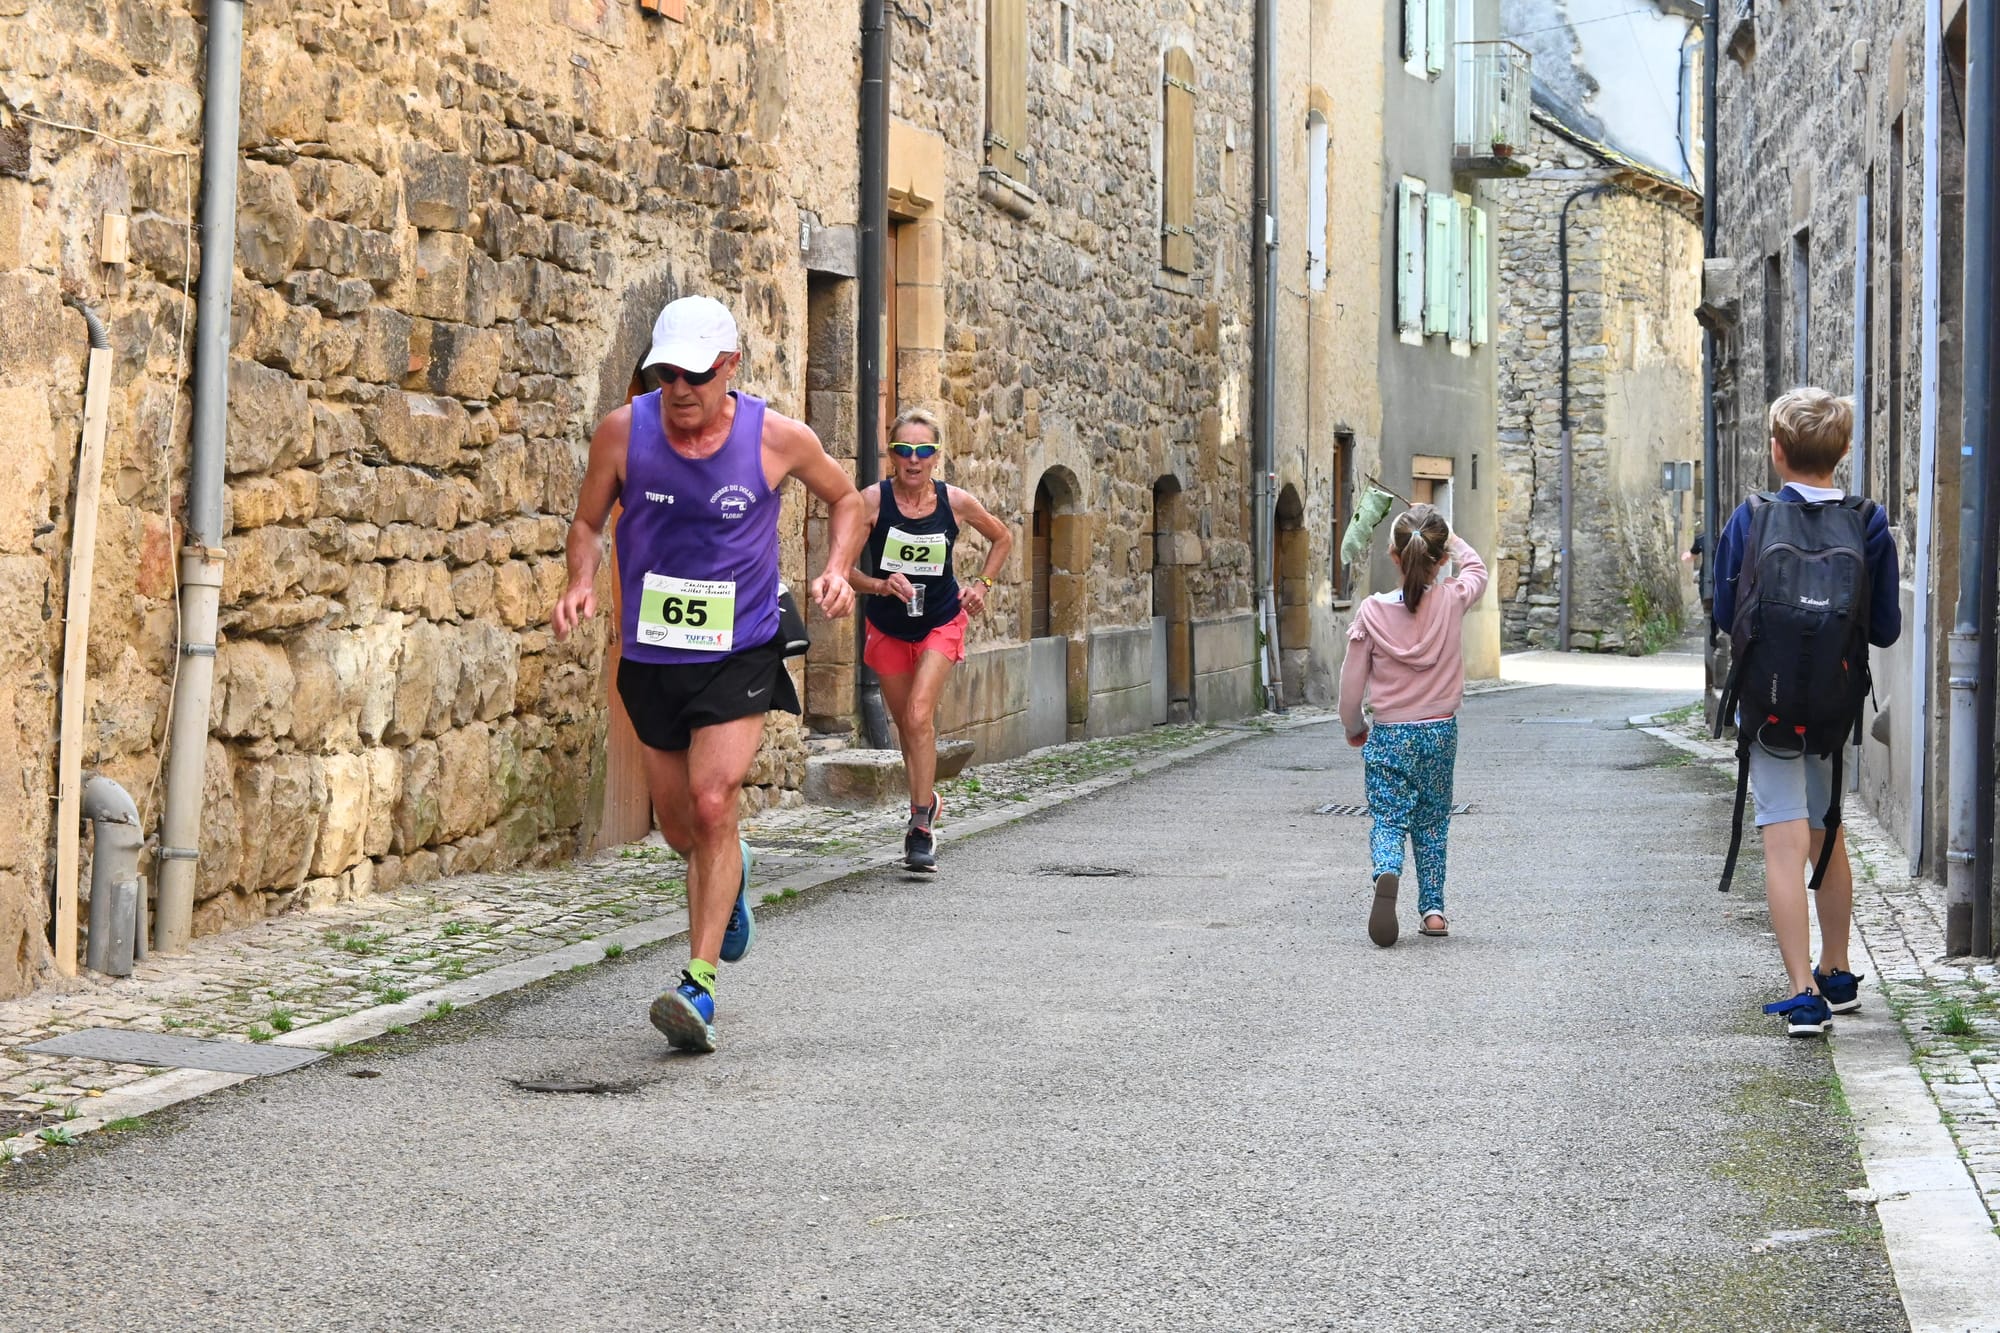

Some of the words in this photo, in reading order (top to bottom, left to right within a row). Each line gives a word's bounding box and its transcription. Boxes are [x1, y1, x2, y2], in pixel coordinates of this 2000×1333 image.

[645, 491, 674, 504] TUFF'S
[710, 486, 729, 503] COURSE
[900, 545, 930, 562] 62
[662, 597, 708, 626] 65
